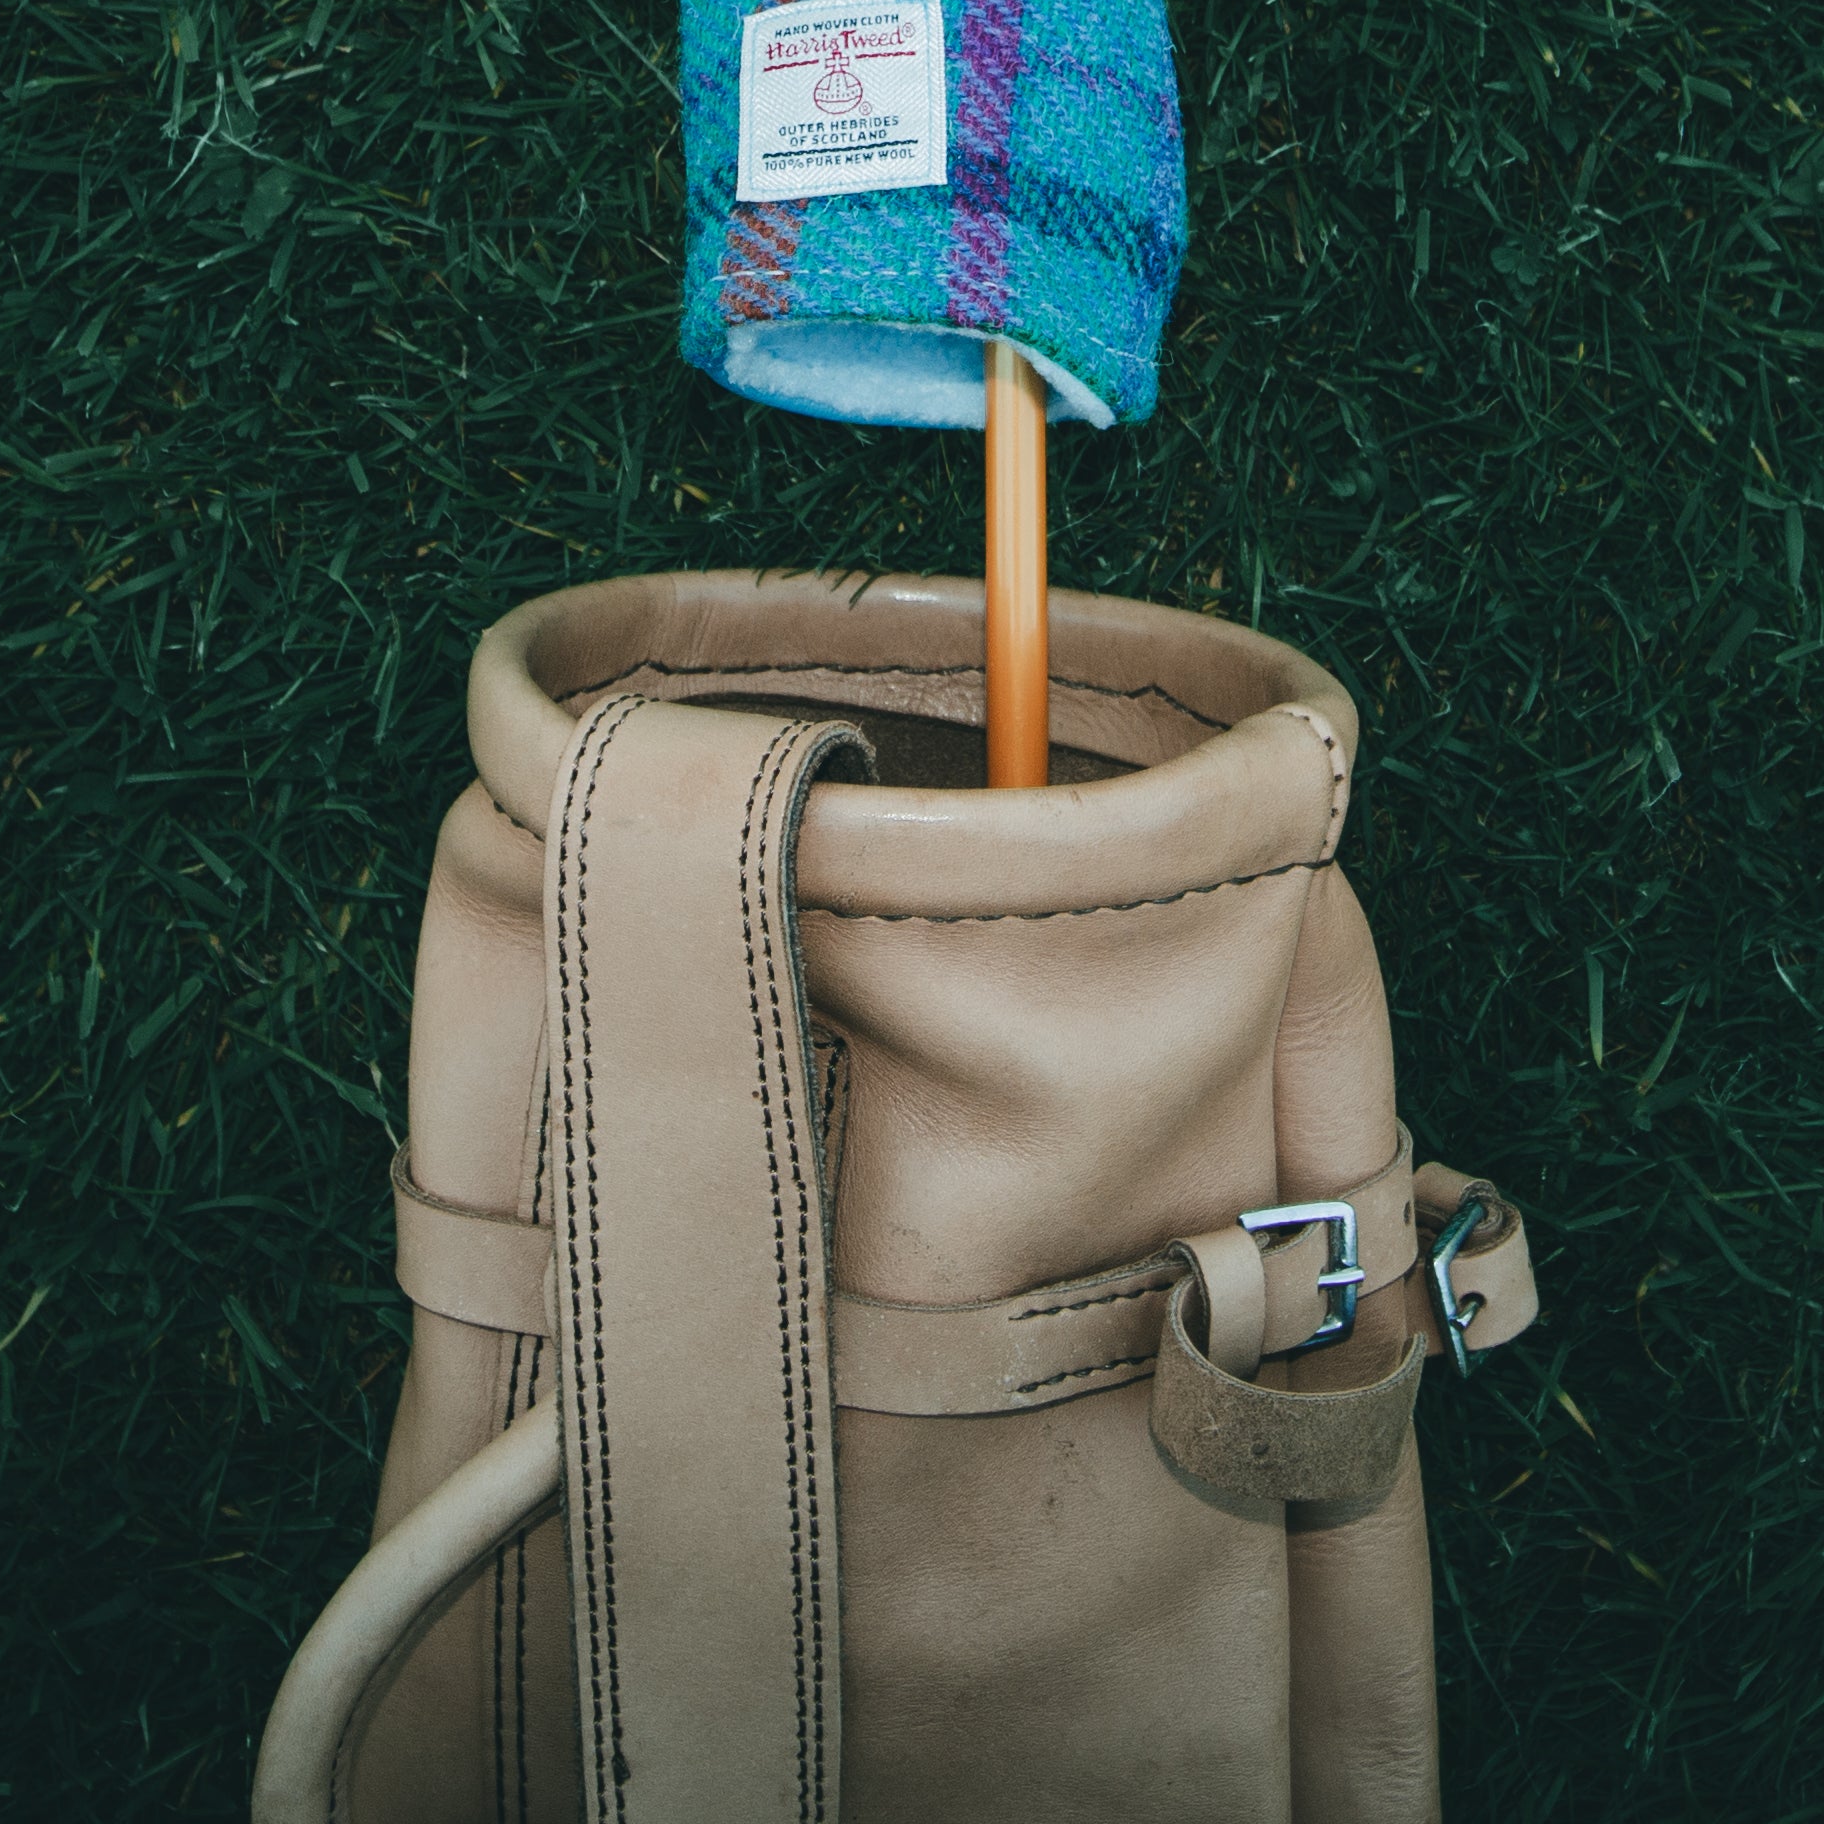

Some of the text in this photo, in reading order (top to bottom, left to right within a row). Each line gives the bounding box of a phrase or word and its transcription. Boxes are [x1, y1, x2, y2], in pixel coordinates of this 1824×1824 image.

[775, 14, 899, 39] HAND WOVEN CLOTH
[766, 34, 839, 60] Harris
[779, 116, 899, 136] OUTER HEBRIDES
[790, 130, 887, 146] OF SCOTLAND
[765, 149, 915, 171] 100% PURE NEW WOOL
